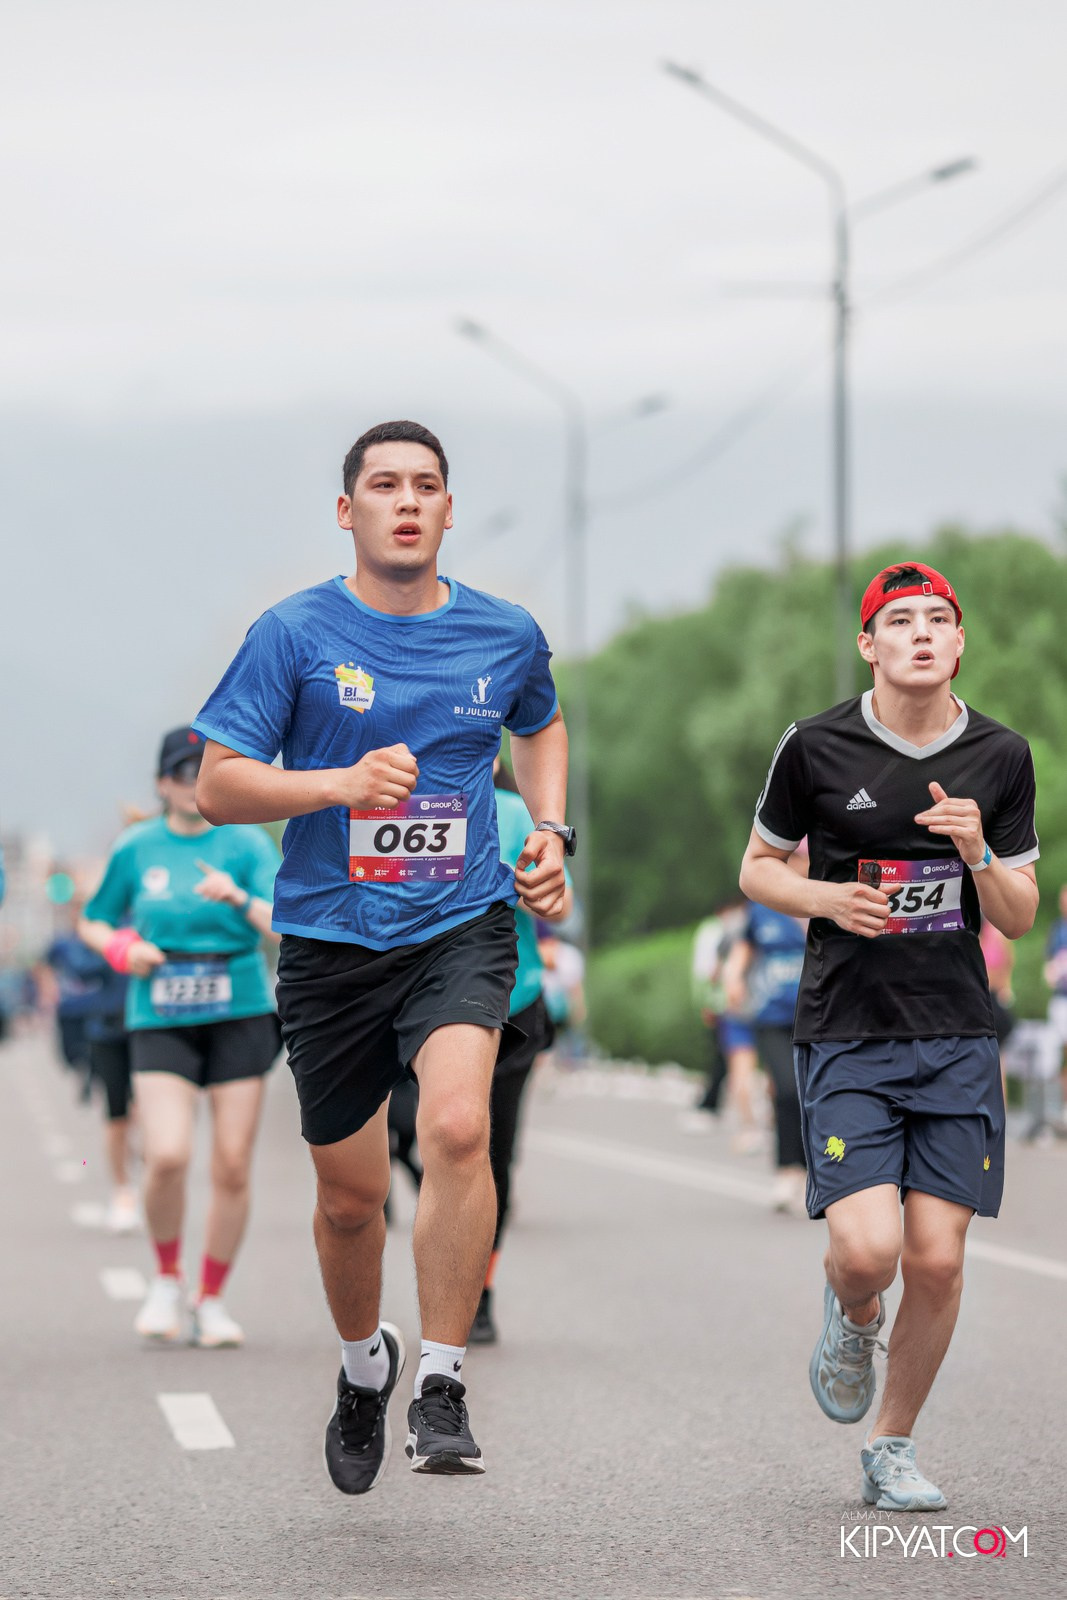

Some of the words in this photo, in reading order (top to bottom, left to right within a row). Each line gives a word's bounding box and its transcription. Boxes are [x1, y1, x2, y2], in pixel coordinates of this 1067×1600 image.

[344, 686, 358, 697] BI
[454, 706, 464, 715] BI
[846, 801, 877, 810] adidas
[373, 823, 451, 854] 063
[931, 864, 950, 873] GROUP
